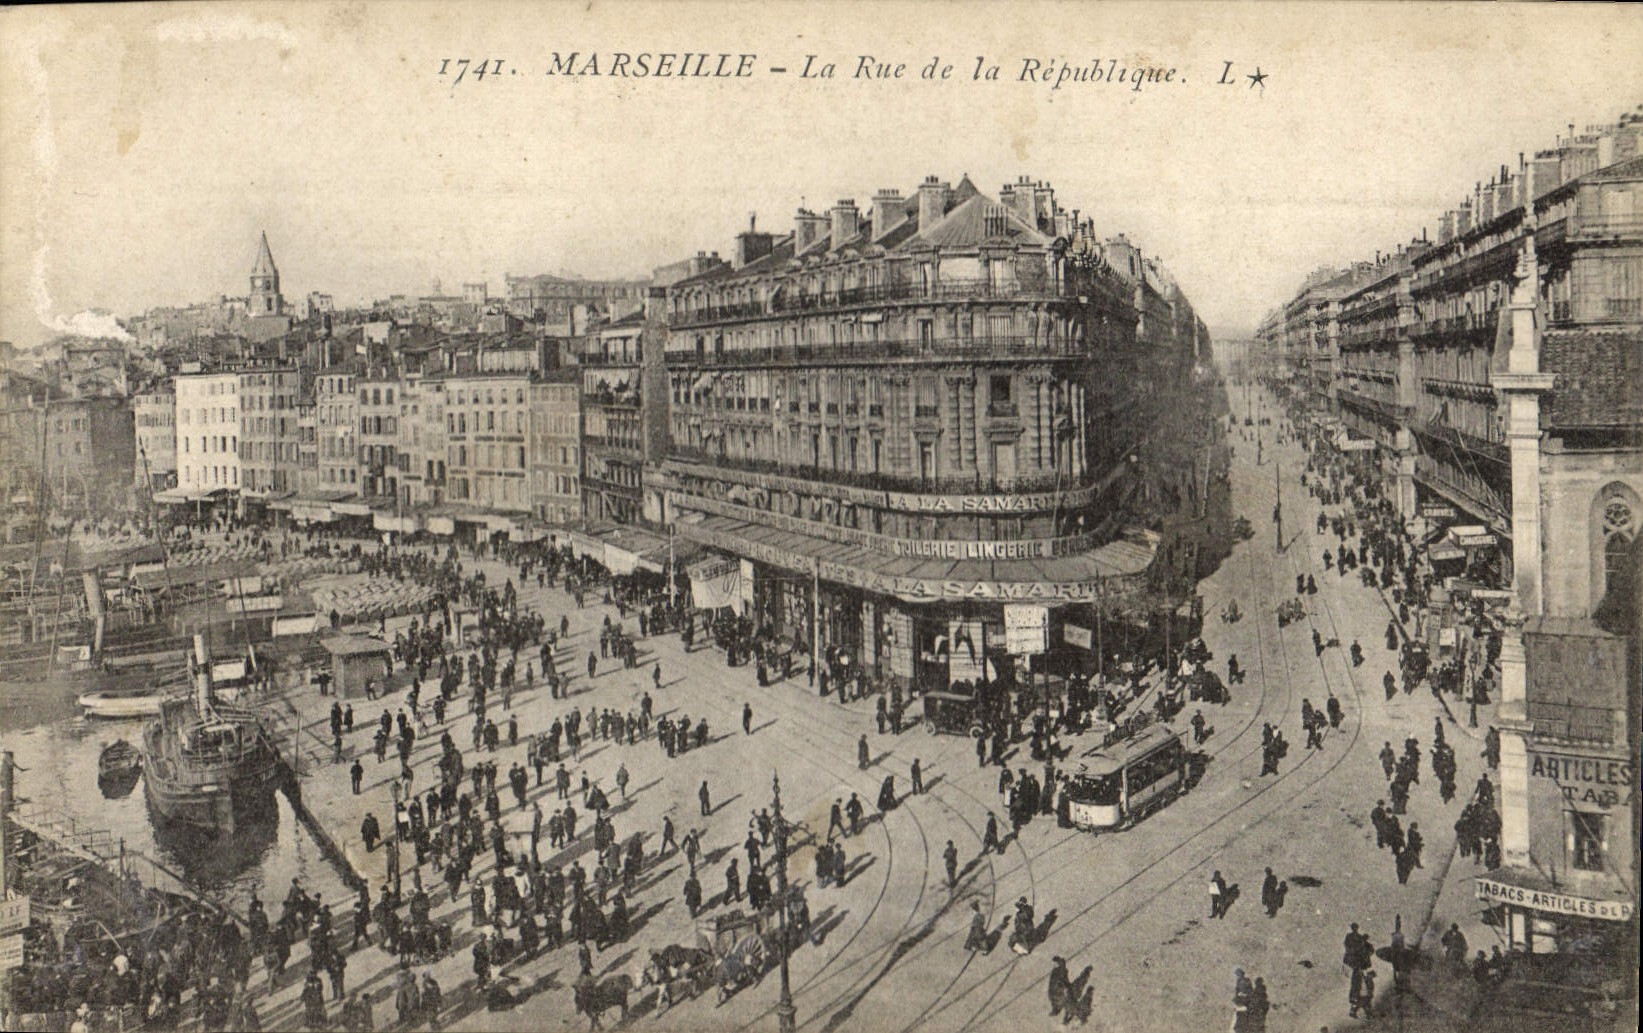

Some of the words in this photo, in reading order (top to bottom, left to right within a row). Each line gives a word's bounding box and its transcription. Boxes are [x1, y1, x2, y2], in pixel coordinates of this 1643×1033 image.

[918, 496, 955, 511] LA
[966, 540, 1044, 560] LINGERIE
[1531, 754, 1633, 787] ARTICLES
